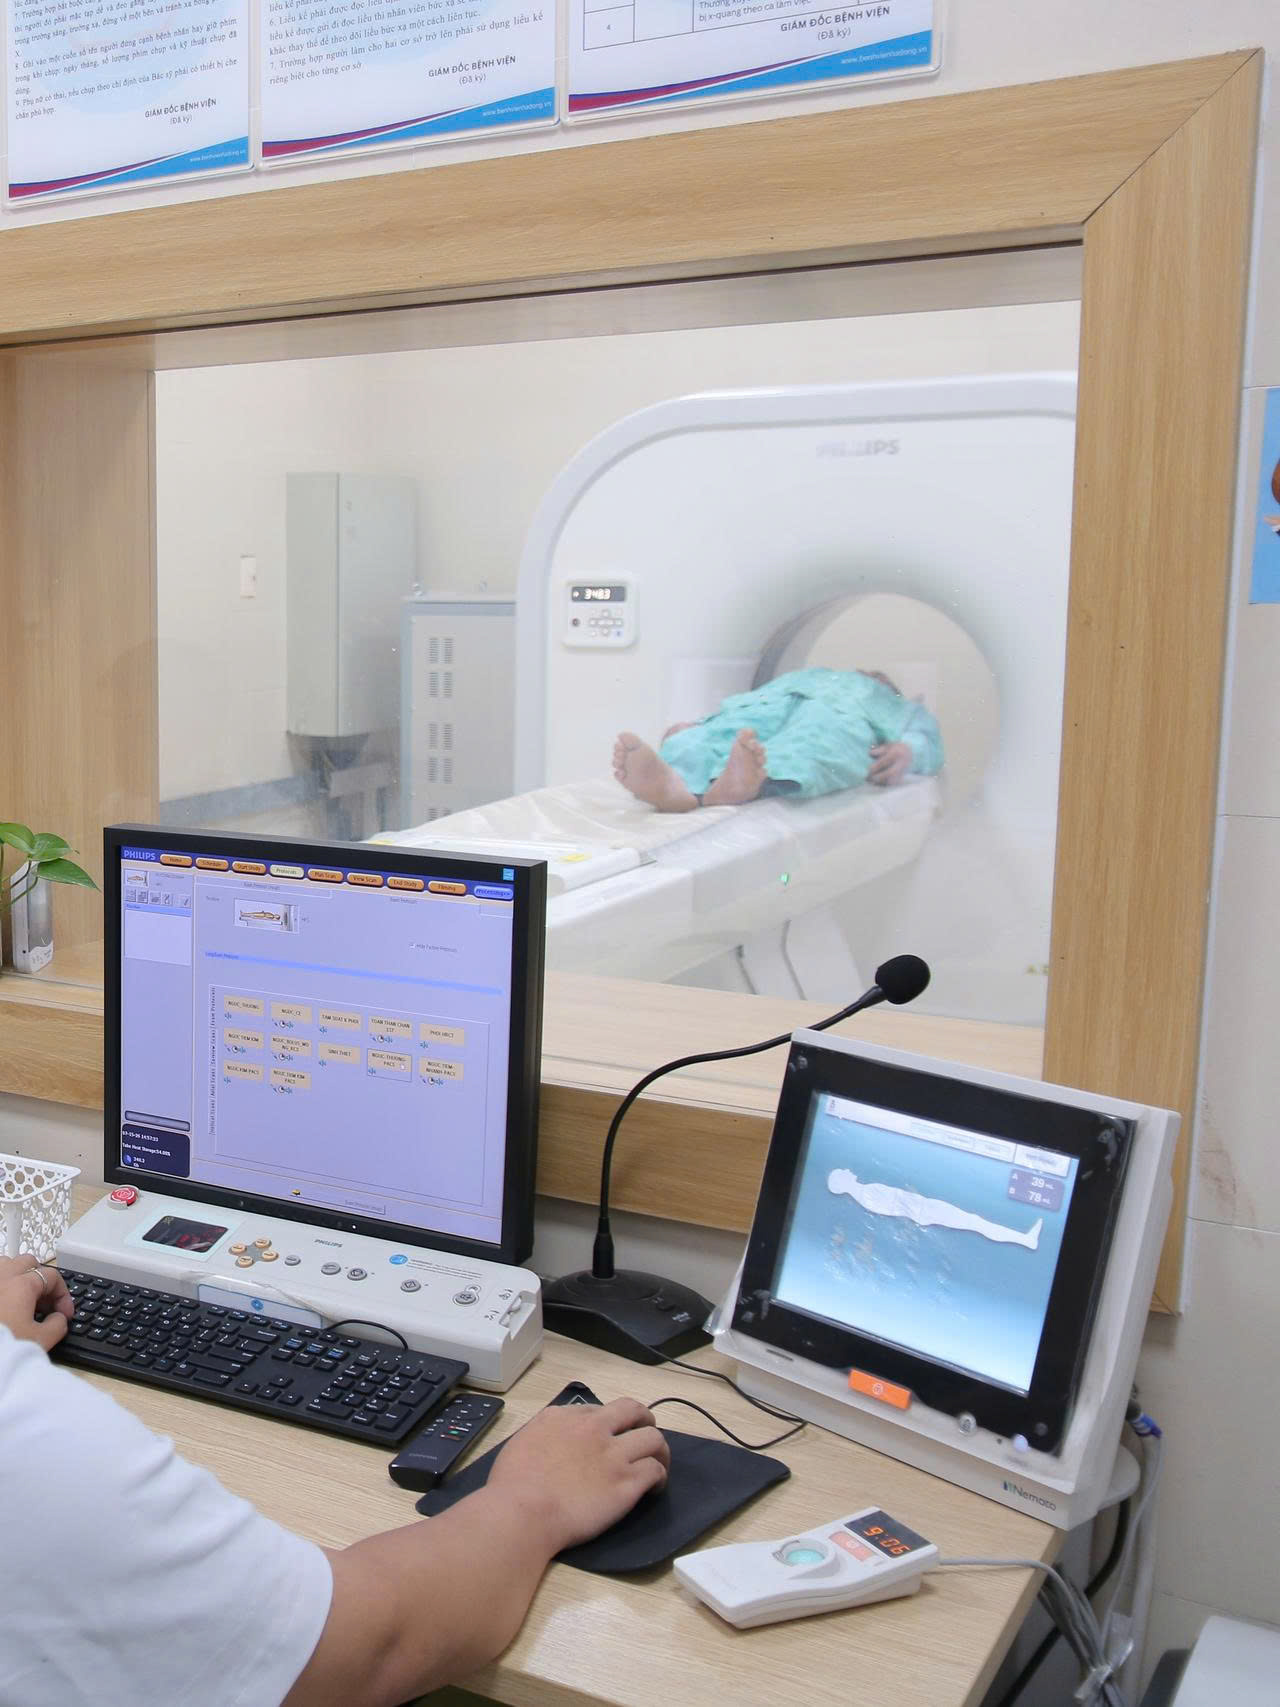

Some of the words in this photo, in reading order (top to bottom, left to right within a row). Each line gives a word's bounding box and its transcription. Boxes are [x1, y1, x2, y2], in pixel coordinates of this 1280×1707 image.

[296, 25, 314, 36] được
[342, 18, 355, 28] đọc
[358, 14, 372, 25] liều
[388, 8, 406, 19] nhân
[409, 4, 426, 14] viên
[310, 8, 327, 20] phải
[329, 4, 347, 16] được
[699, 14, 707, 22] bị
[708, 8, 742, 20] x-quang
[744, 4, 762, 14] theo
[780, 18, 806, 32] GIÁM
[809, 14, 832, 27] ĐỐC
[835, 10, 863, 25] BỆNH
[866, 6, 890, 19] VIỆN
[270, 44, 286, 56] khác
[288, 42, 304, 54] thay
[331, 34, 348, 44] theo
[364, 27, 379, 38] liều
[381, 24, 395, 34] bức
[410, 18, 425, 29] một
[426, 15, 445, 26] cách
[448, 12, 463, 23] liên
[280, 58, 306, 69] Trường
[309, 54, 323, 64] hợp
[326, 50, 347, 61] người
[351, 46, 365, 56] làm
[368, 43, 382, 53] cho
[385, 39, 397, 49] hai
[440, 30, 453, 40] lên
[456, 25, 474, 38] phải
[490, 18, 510, 31] dụng
[514, 16, 530, 26] liều
[818, 30, 834, 41] (Đã
[837, 28, 852, 39] ký)
[428, 67, 450, 78] GIÁM
[452, 60, 470, 74] ĐỐC
[472, 58, 495, 71] BỆNH
[496, 54, 516, 66] VIỆN
[270, 74, 289, 85] riêng
[290, 70, 305, 81] biệt
[306, 68, 320, 78] cho
[459, 75, 473, 86] (Đã
[145, 108, 162, 118] GIÁM
[164, 103, 179, 115] ĐỐC
[180, 102, 199, 113] BỆNH
[200, 98, 217, 109] VIỆN
[124, 850, 156, 861] PHILIPS
[1032, 1176, 1045, 1189] 39
[314, 1238, 343, 1248] PHILIPS
